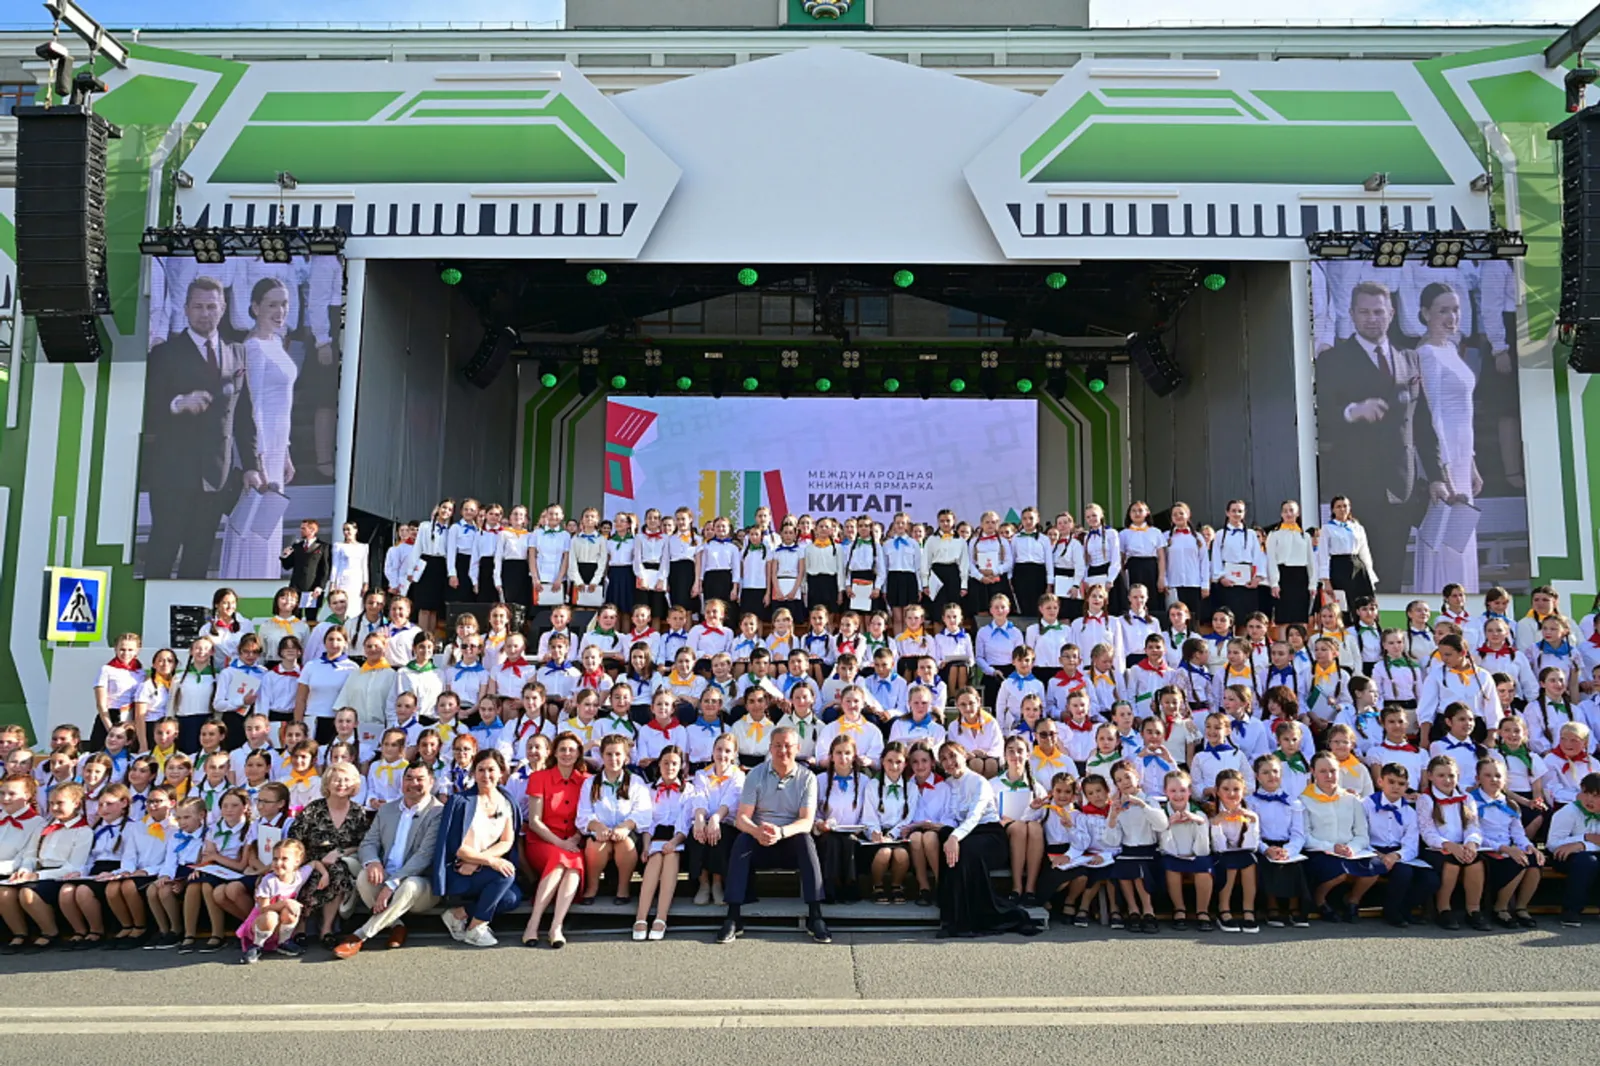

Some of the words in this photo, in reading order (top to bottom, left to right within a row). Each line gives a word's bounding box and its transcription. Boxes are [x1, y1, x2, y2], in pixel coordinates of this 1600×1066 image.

[808, 470, 933, 480] МЕЖДУНАРОДНАЯ
[808, 481, 870, 490] КНИЖНАЯ
[874, 481, 934, 491] ЯРМАРКА
[808, 493, 912, 512] КИТАП-
